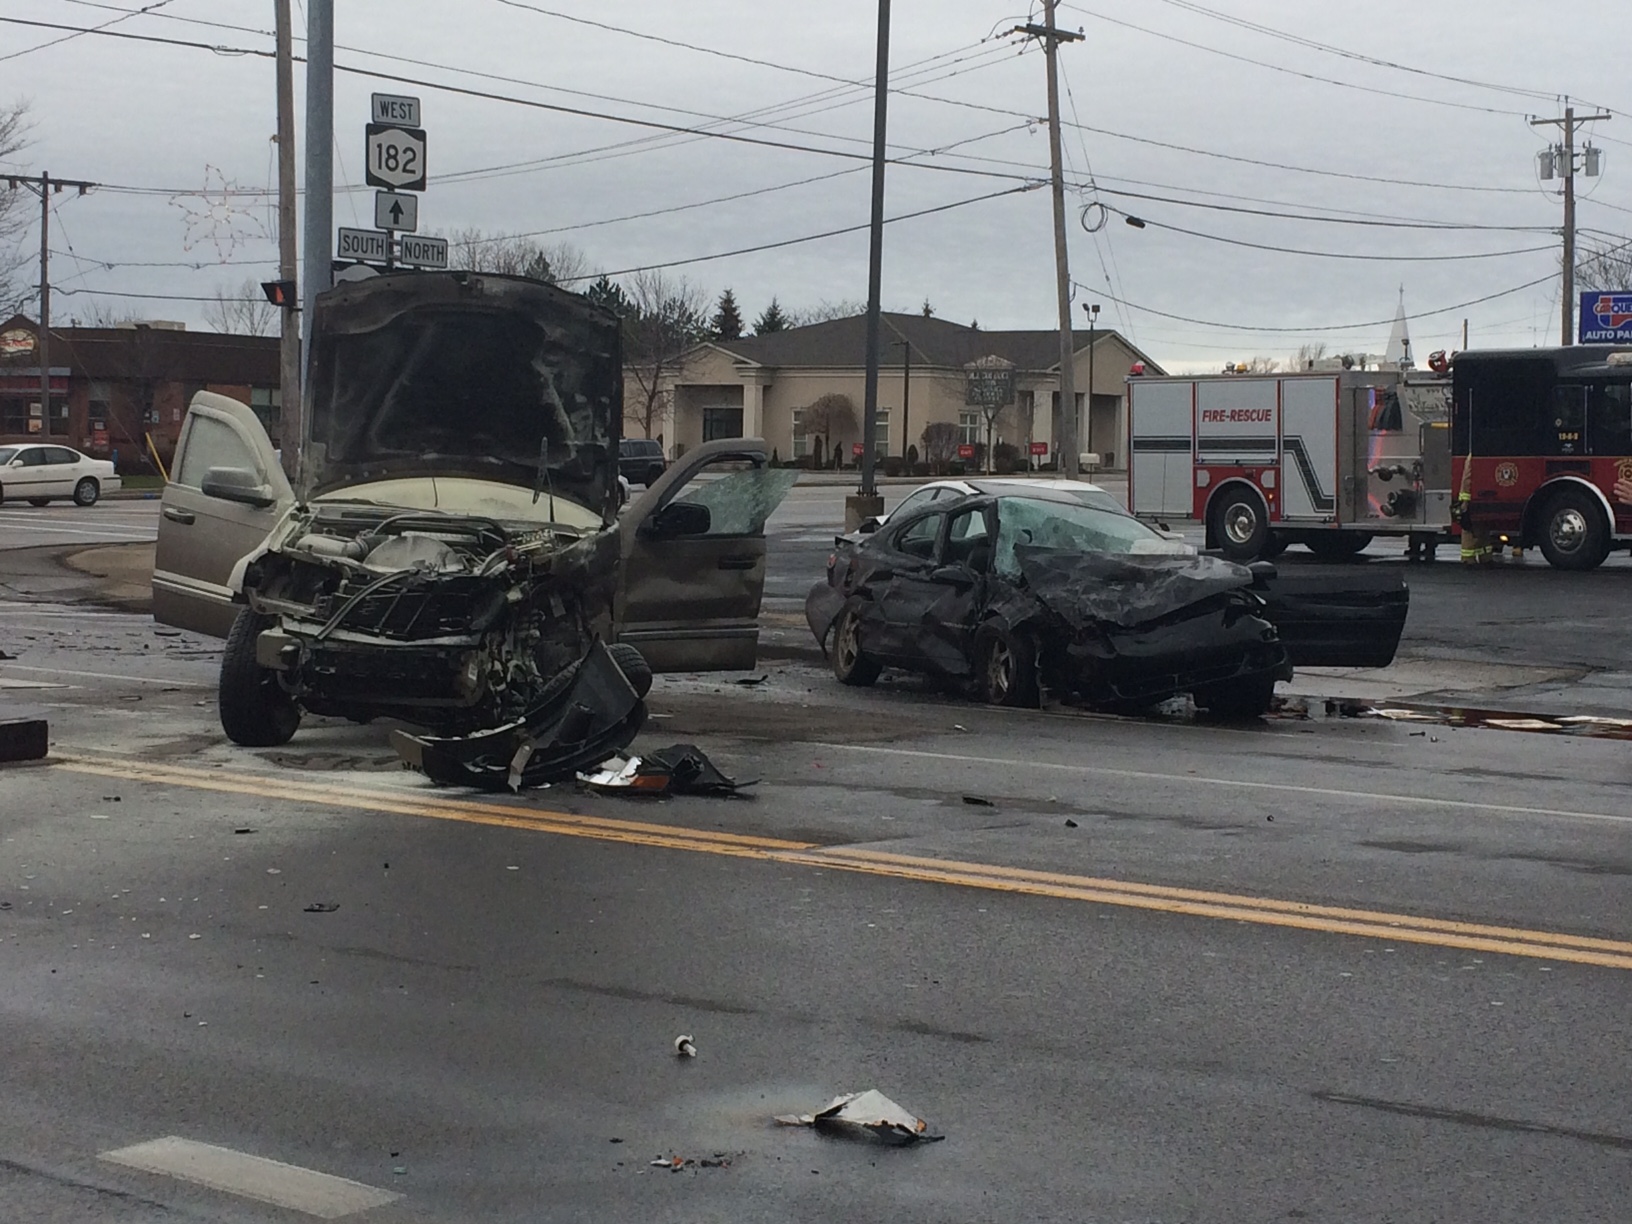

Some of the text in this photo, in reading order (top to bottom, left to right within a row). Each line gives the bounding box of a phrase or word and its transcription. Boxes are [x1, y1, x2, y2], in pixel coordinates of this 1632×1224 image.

[380, 100, 413, 121] WEST
[376, 142, 417, 175] 182
[342, 234, 385, 256] SOUTH
[404, 241, 445, 263] NORTH
[1585, 330, 1614, 340] AUTO
[1202, 409, 1272, 423] FIRE-RESCUE
